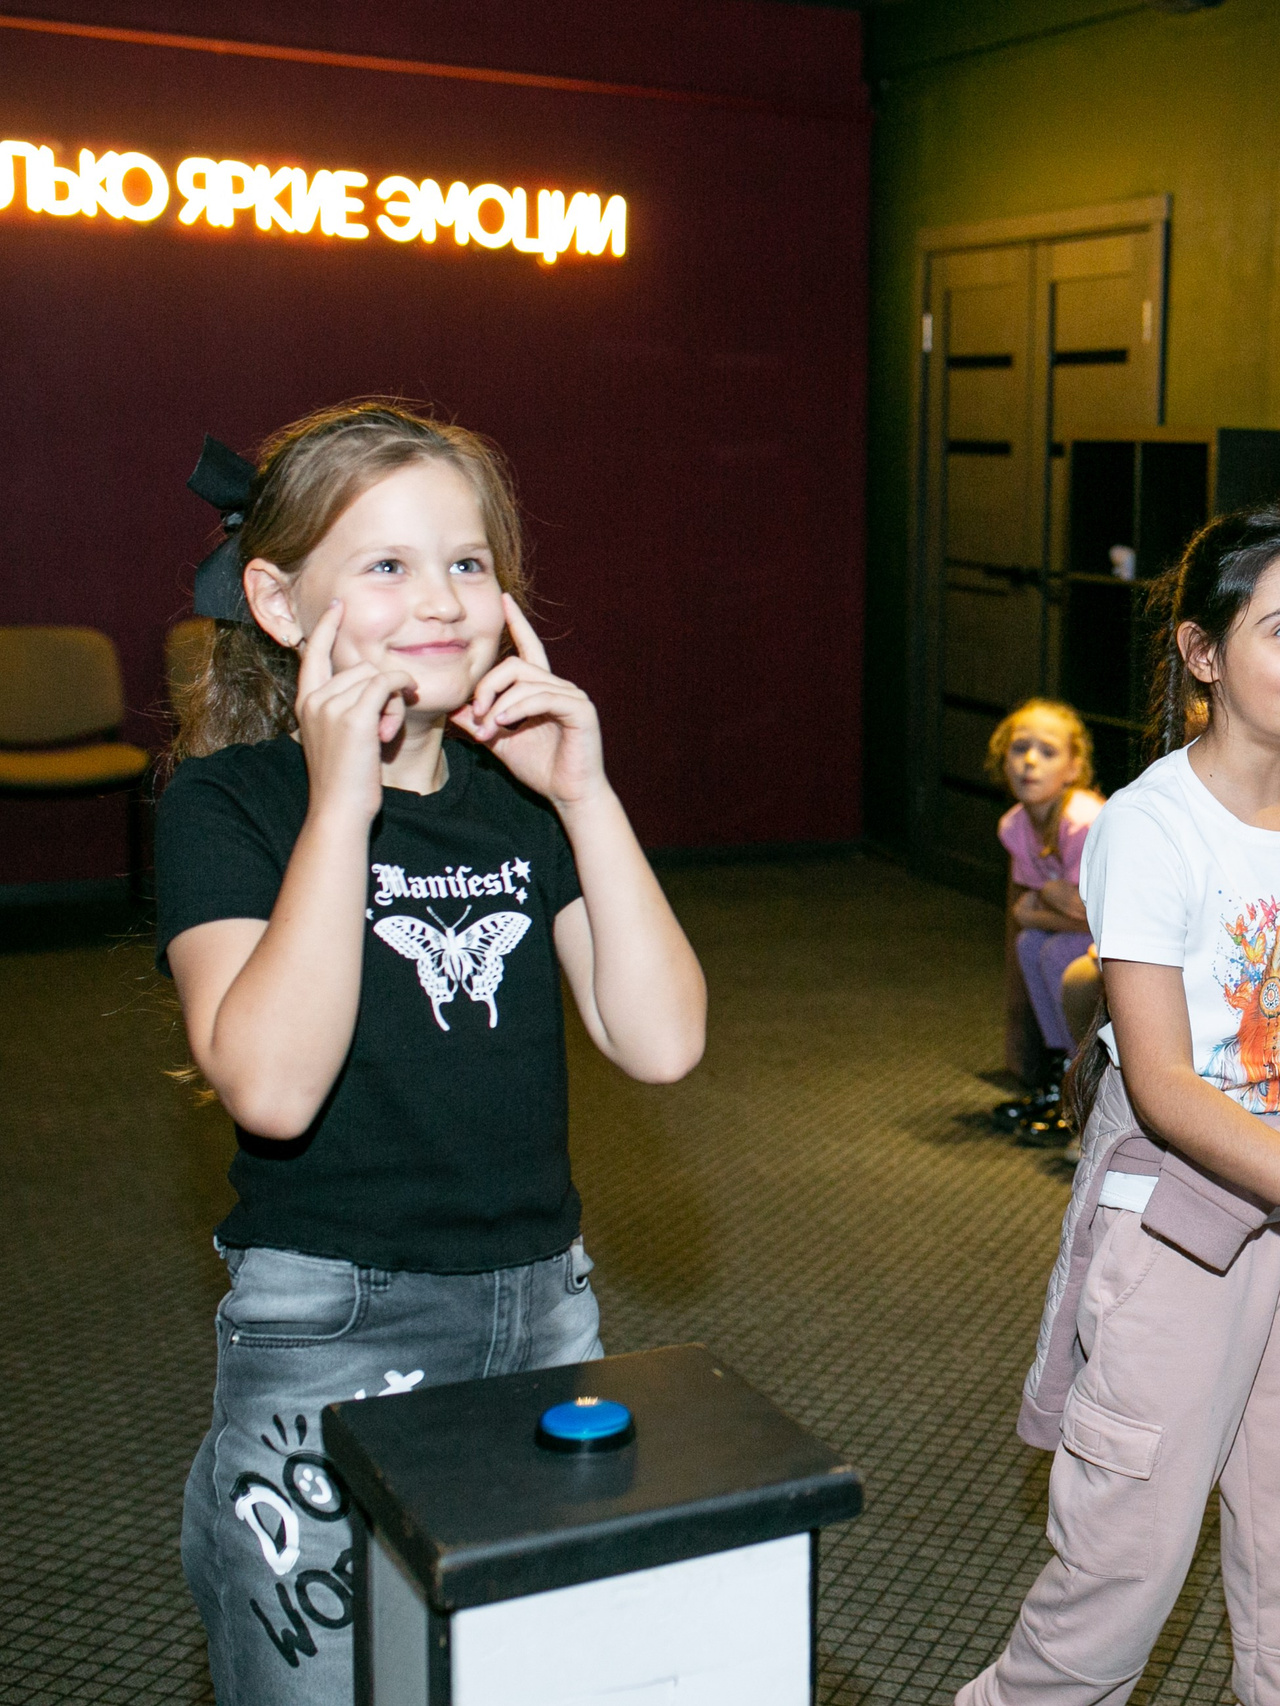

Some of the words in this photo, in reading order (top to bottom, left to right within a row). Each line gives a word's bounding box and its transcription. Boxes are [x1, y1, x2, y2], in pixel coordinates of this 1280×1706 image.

[176, 156, 370, 240] ЯРКИЕ
[375, 175, 628, 265] ЭМОЦИИ
[371, 860, 518, 906] Manifest
